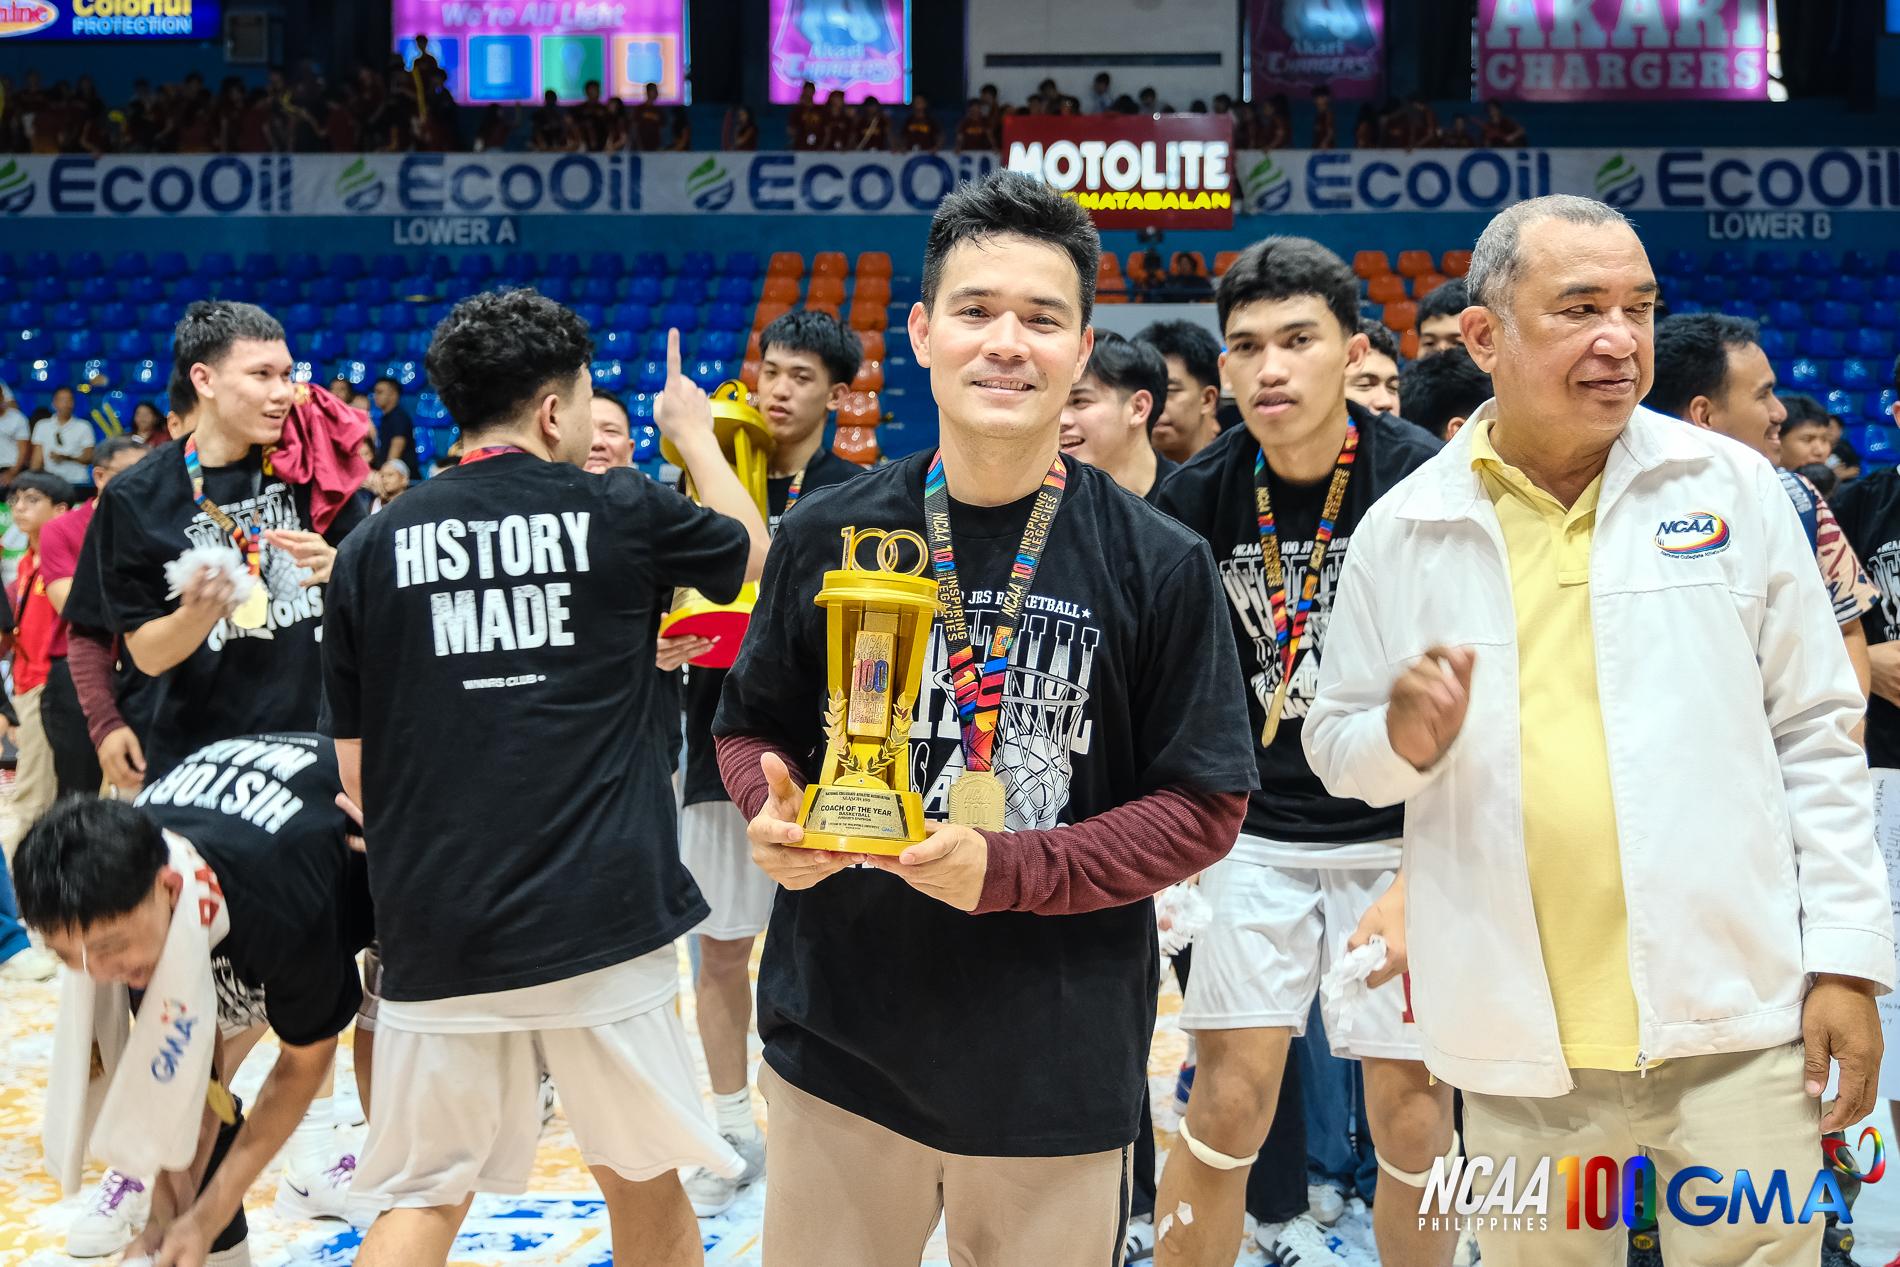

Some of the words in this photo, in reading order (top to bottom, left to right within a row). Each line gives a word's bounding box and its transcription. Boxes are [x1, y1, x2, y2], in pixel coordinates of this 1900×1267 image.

[72, 16, 192, 35] PROTECTION
[1485, 0, 1763, 48] AKARI
[1487, 53, 1762, 89] CHARGERS
[48, 154, 294, 213] EcoOil
[399, 154, 642, 212] EcoOil
[1008, 140, 1230, 191] MOTOLITE
[1306, 151, 1549, 209] EcoOil
[1656, 150, 1900, 209] EcoOil
[394, 219, 489, 245] LOWER
[494, 219, 516, 244] A
[1708, 212, 1807, 239] LOWER
[1813, 212, 1831, 238] B
[932, 512, 949, 544] NCAA
[1020, 491, 1048, 550] INSPIRING
[1029, 495, 1058, 552] LEGACIES
[1656, 519, 1715, 536] NCAA
[394, 511, 590, 588] HISTORY
[841, 526, 929, 577] 100
[933, 544, 956, 573] 100
[1010, 553, 1037, 580] 100
[430, 582, 575, 657] MADE
[937, 575, 958, 643] LEGACIES
[947, 574, 968, 641] INSPIRING
[968, 590, 992, 604] JRS
[1001, 581, 1024, 619] NCAA
[853, 658, 889, 694] 100
[820, 804, 845, 812] COACH
[858, 806, 872, 814] THE
[873, 808, 892, 817] YEAR
[964, 804, 992, 825] 100
[151, 1017, 197, 1084] GMA
